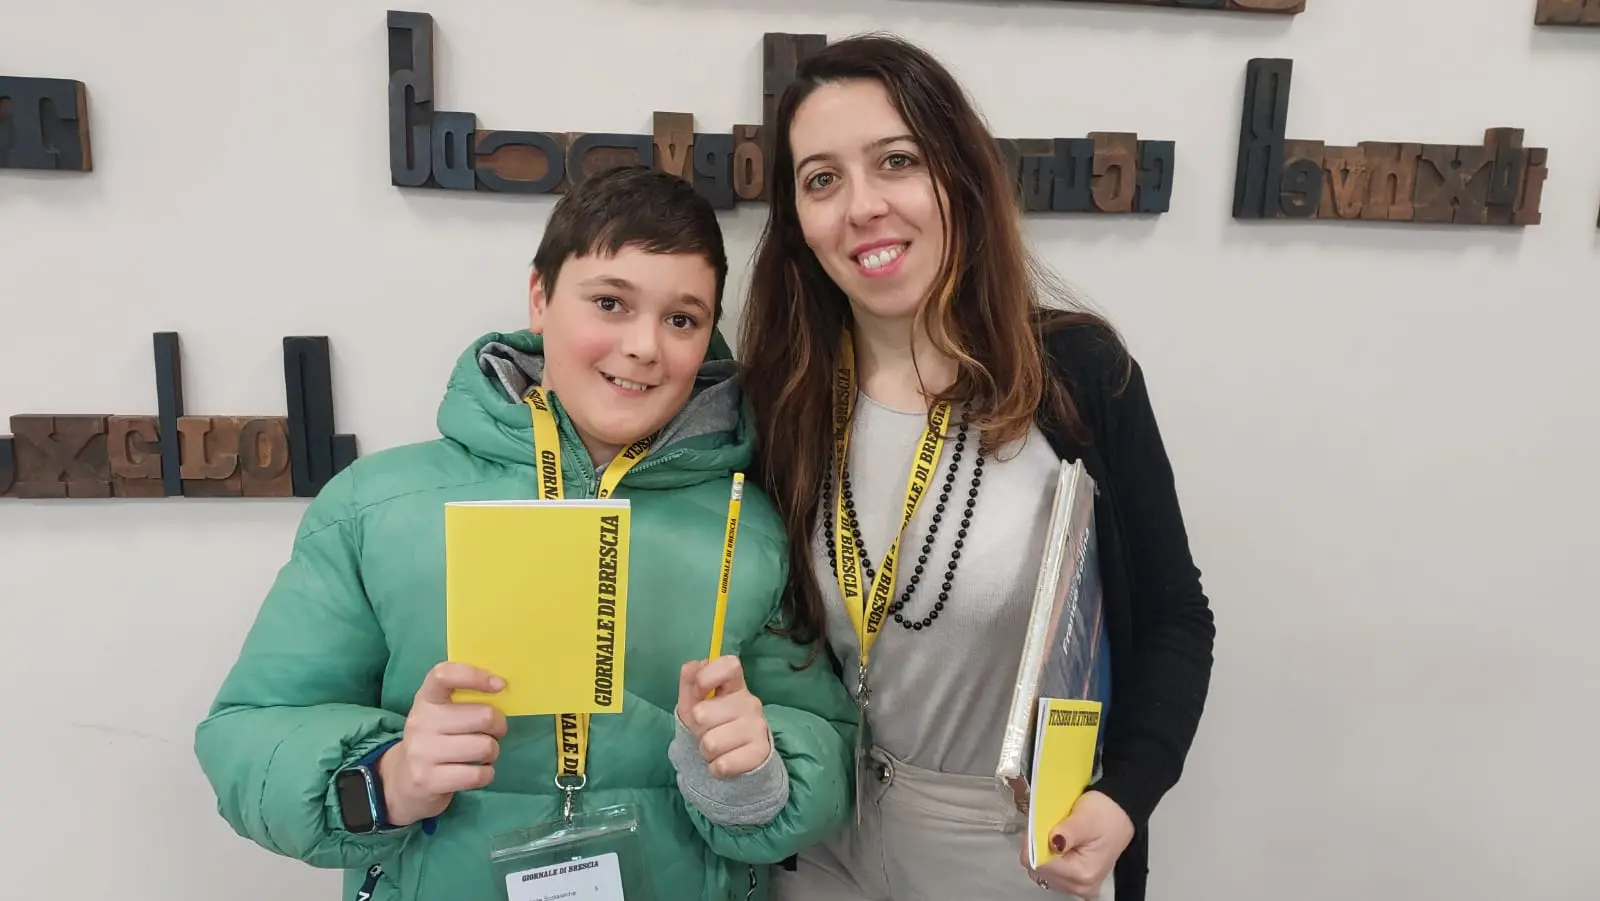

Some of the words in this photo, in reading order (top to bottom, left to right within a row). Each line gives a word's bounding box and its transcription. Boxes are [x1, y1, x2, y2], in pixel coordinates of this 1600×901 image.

[920, 401, 948, 463] BRESCIA
[915, 463, 930, 484] DI
[598, 515, 619, 595] BRESCIA
[721, 559, 731, 594] GIORNALE
[728, 518, 737, 549] BRESCIA
[841, 534, 859, 598] BRESCIA
[883, 556, 894, 573] DI
[598, 597, 616, 618] DI
[867, 573, 892, 634] BRESCIA
[595, 619, 615, 706] GIORNALE
[522, 868, 558, 882] GIORNALE
[560, 867, 567, 875] DI
[568, 861, 599, 873] BRESCIA
